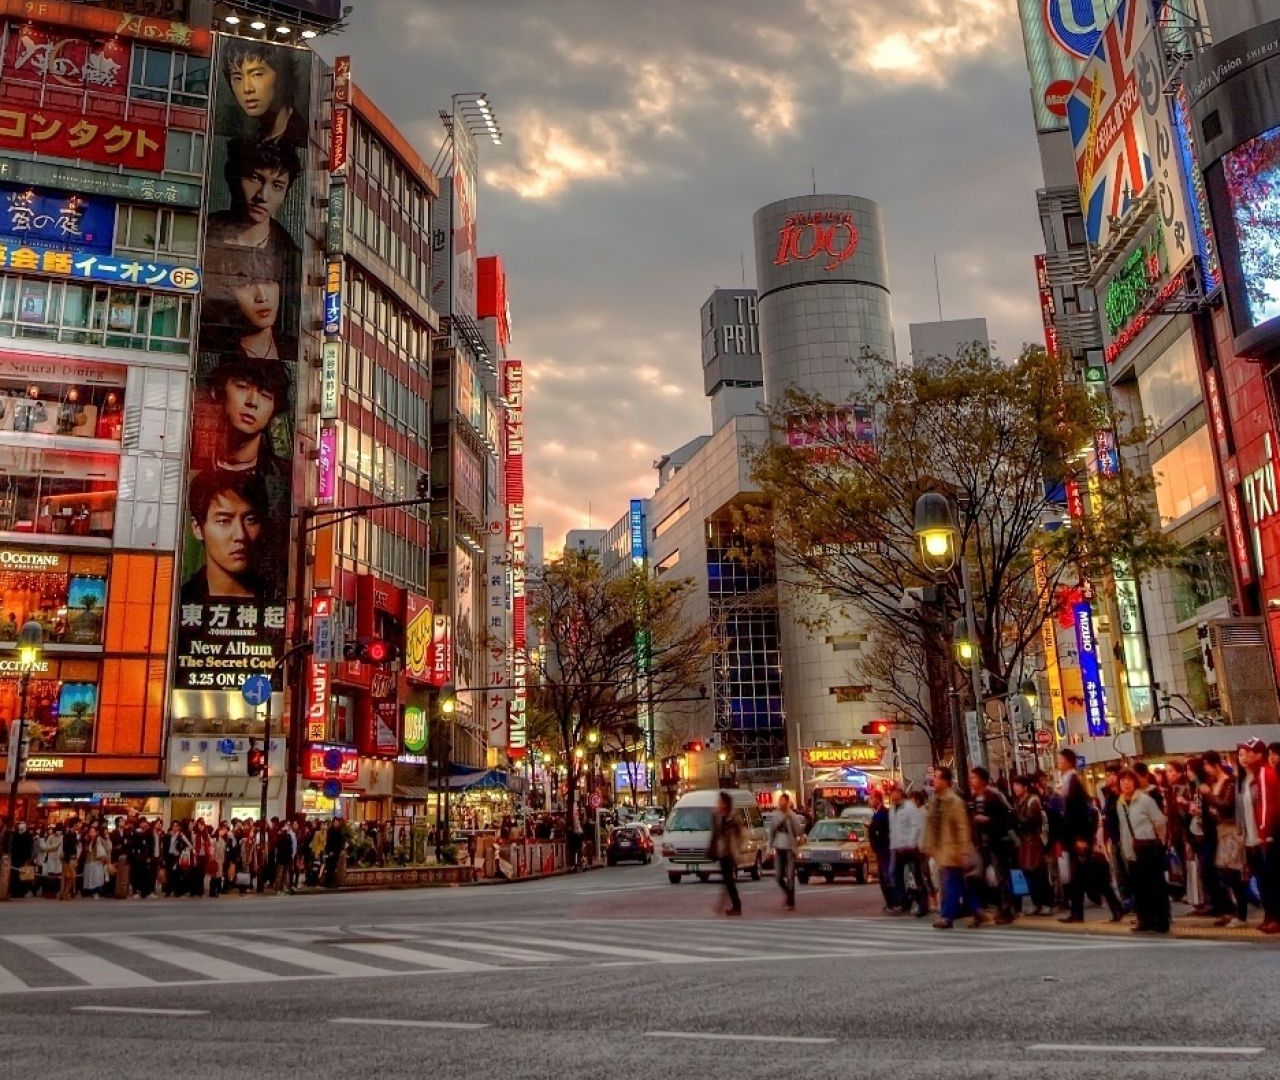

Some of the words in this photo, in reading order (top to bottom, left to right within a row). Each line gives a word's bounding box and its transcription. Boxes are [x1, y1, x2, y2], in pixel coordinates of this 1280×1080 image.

[1213, 56, 1243, 85] Vision
[785, 212, 855, 224] SHIBUYA
[774, 222, 859, 270] 109
[173, 270, 195, 284] 6F
[11, 361, 55, 375] Natural
[63, 364, 104, 380] Dining
[181, 604, 285, 629] 東方神起
[1078, 611, 1092, 652] MIZUHO
[190, 641, 222, 654] New
[225, 642, 272, 655] Album
[179, 656, 204, 668] The
[206, 657, 248, 668] Secret
[188, 673, 213, 686] 3.25
[216, 674, 236, 686] ON
[491, 647, 503, 732] マルナン
[810, 750, 850, 761] SPRING
[853, 748, 877, 760] FAIR
